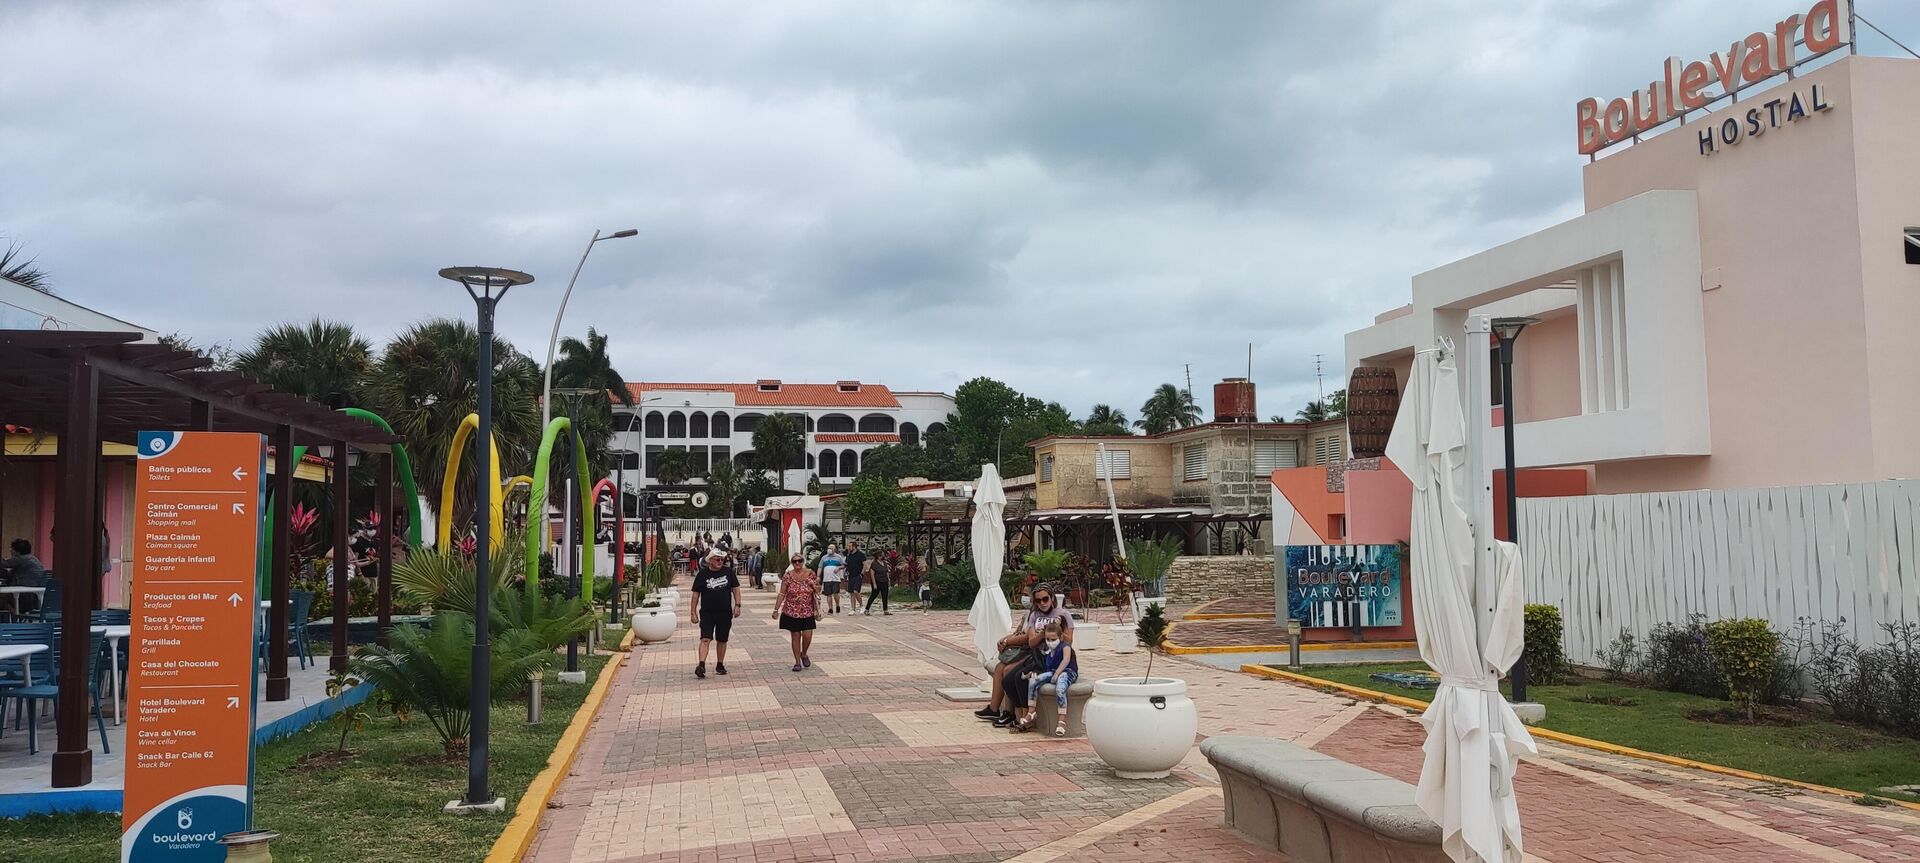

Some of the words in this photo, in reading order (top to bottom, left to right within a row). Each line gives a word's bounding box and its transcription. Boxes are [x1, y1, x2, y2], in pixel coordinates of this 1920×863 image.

[1577, 0, 1850, 155] Boulevard
[1698, 83, 1832, 156] HOSTAL
[176, 465, 212, 475] públicos
[1308, 546, 1378, 566] HOSTAL
[1298, 568, 1390, 585] Boulevard
[1298, 586, 1392, 598] VARADERO
[176, 616, 205, 624] Crepes
[153, 831, 216, 843] boulevard
